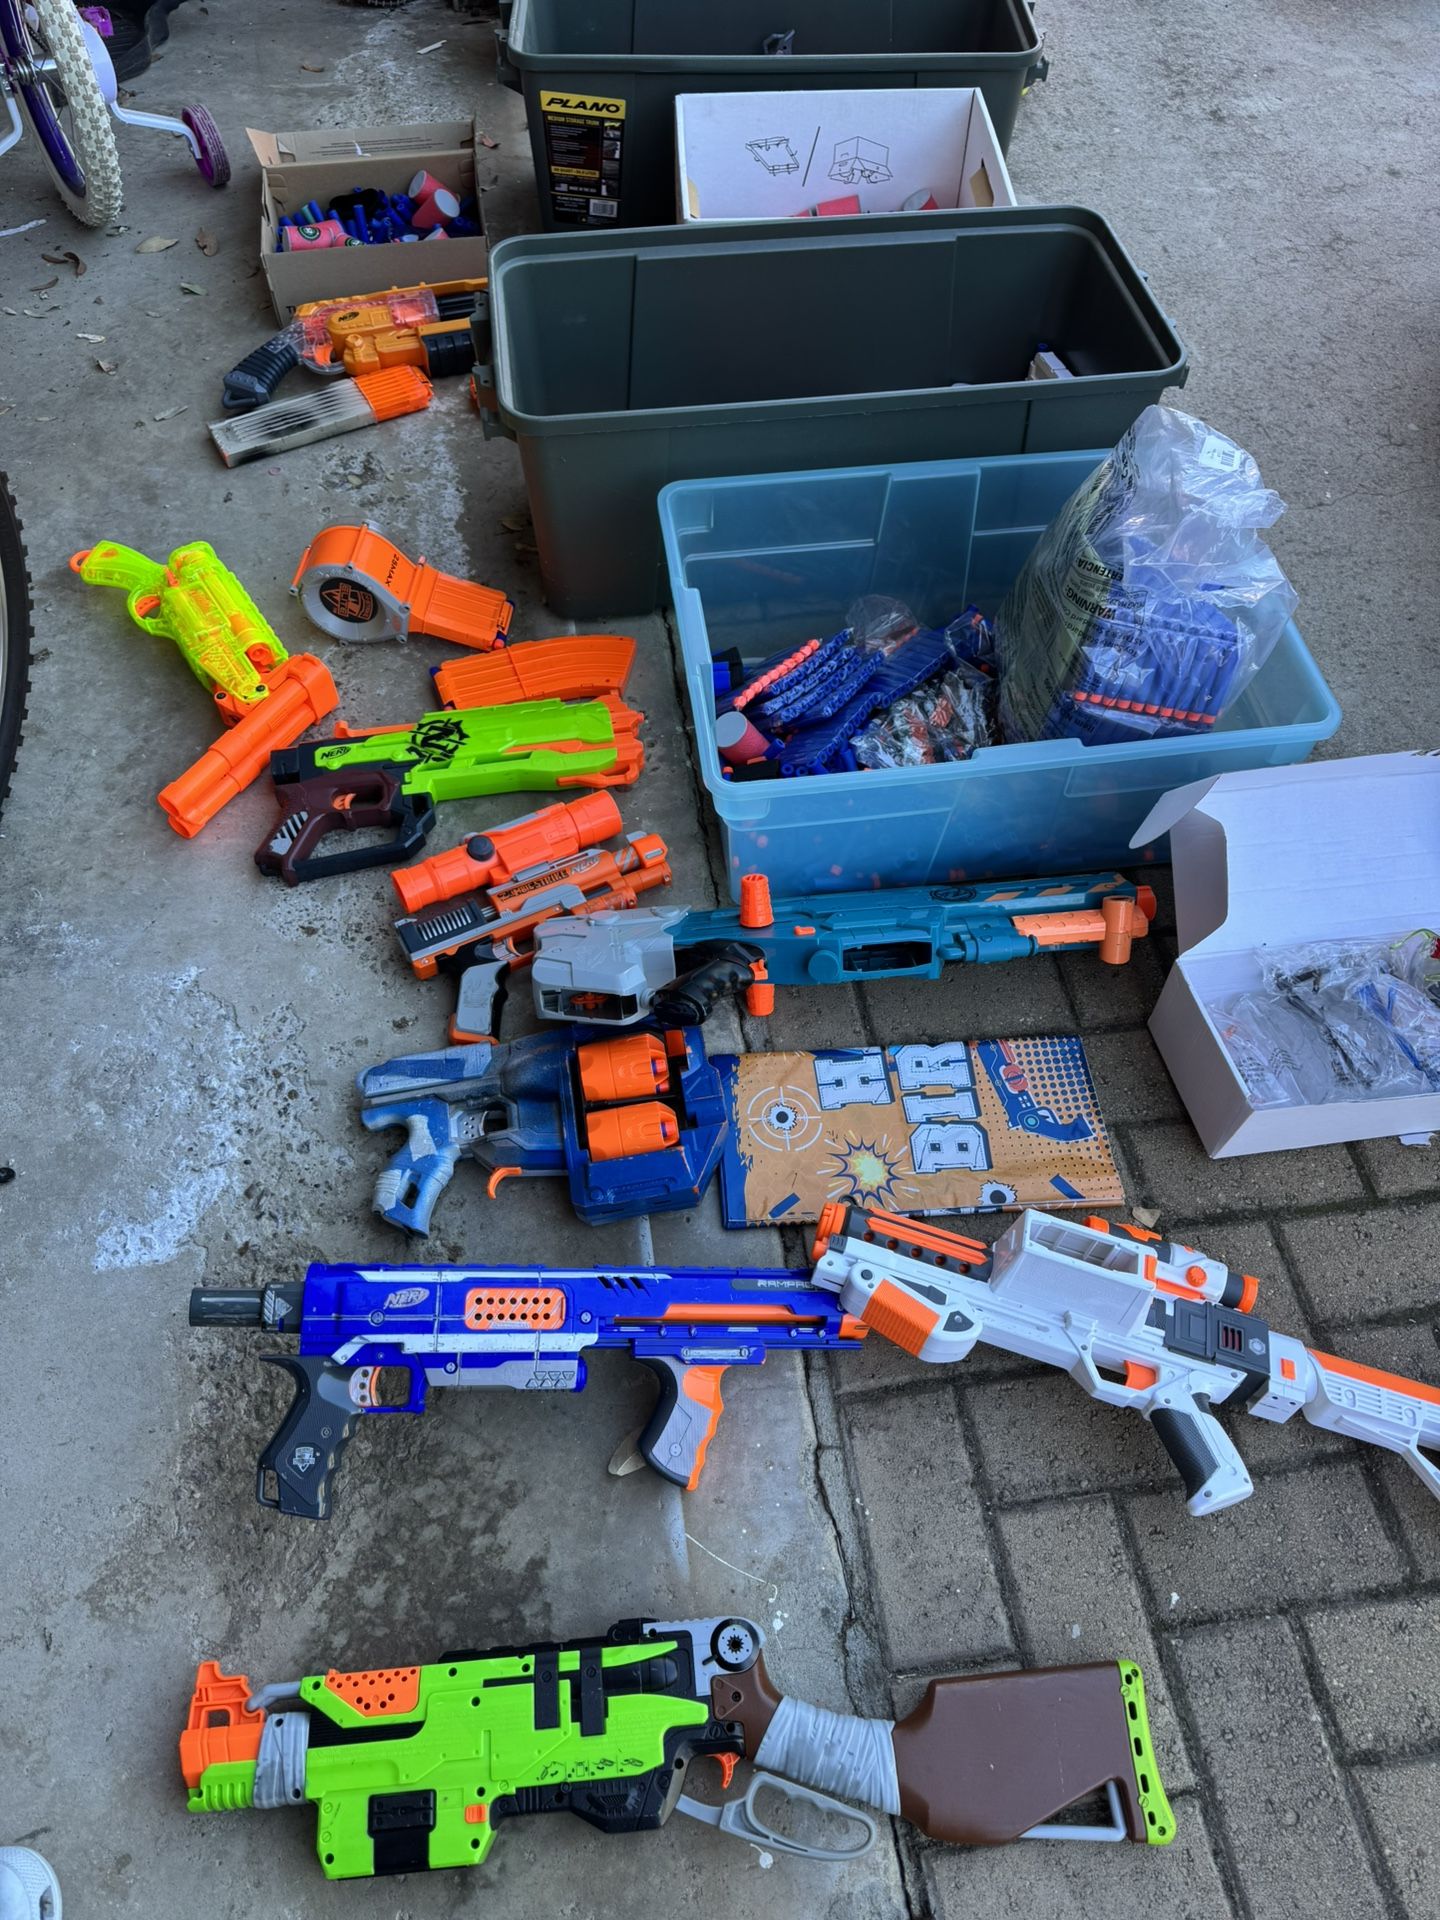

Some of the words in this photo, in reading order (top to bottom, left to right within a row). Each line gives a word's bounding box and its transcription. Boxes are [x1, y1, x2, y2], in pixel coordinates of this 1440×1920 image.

[546, 97, 621, 113] PLANO
[1065, 585, 1116, 620] WARNING:
[320, 745, 352, 760] NERF
[569, 855, 600, 878] NERF
[895, 1041, 992, 1174] BIR
[757, 1279, 814, 1289] RAMPAG
[384, 1288, 430, 1310] NERF
